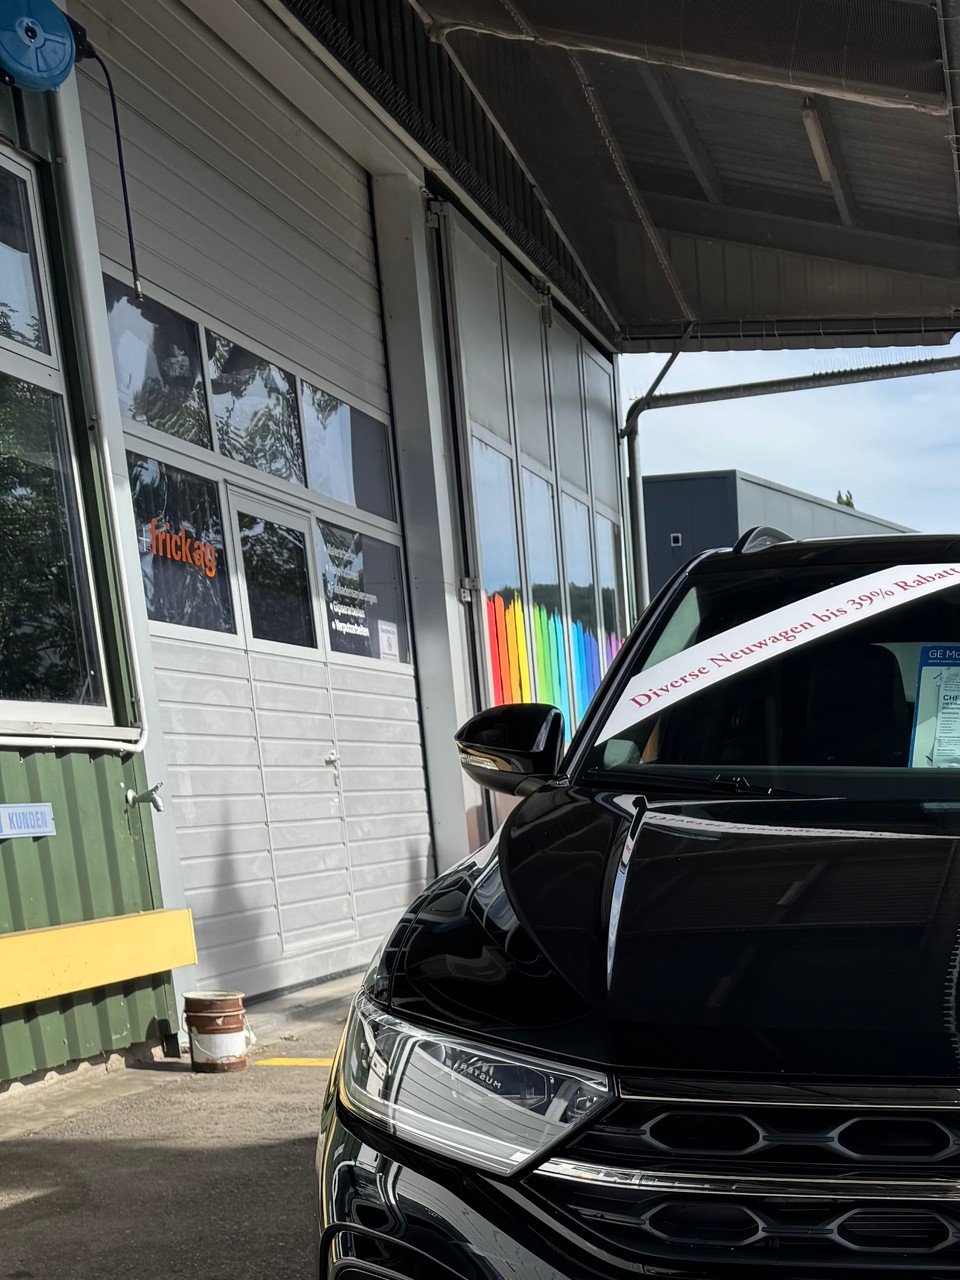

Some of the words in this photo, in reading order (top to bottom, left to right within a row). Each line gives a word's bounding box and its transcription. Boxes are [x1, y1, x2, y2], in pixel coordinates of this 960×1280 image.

[629, 665, 710, 708] Diverse
[708, 619, 816, 668] Neuwagen
[812, 608, 848, 623] bis
[847, 588, 895, 610] 39%
[928, 649, 944, 658] GE
[8, 811, 48, 830] KUNDEN
